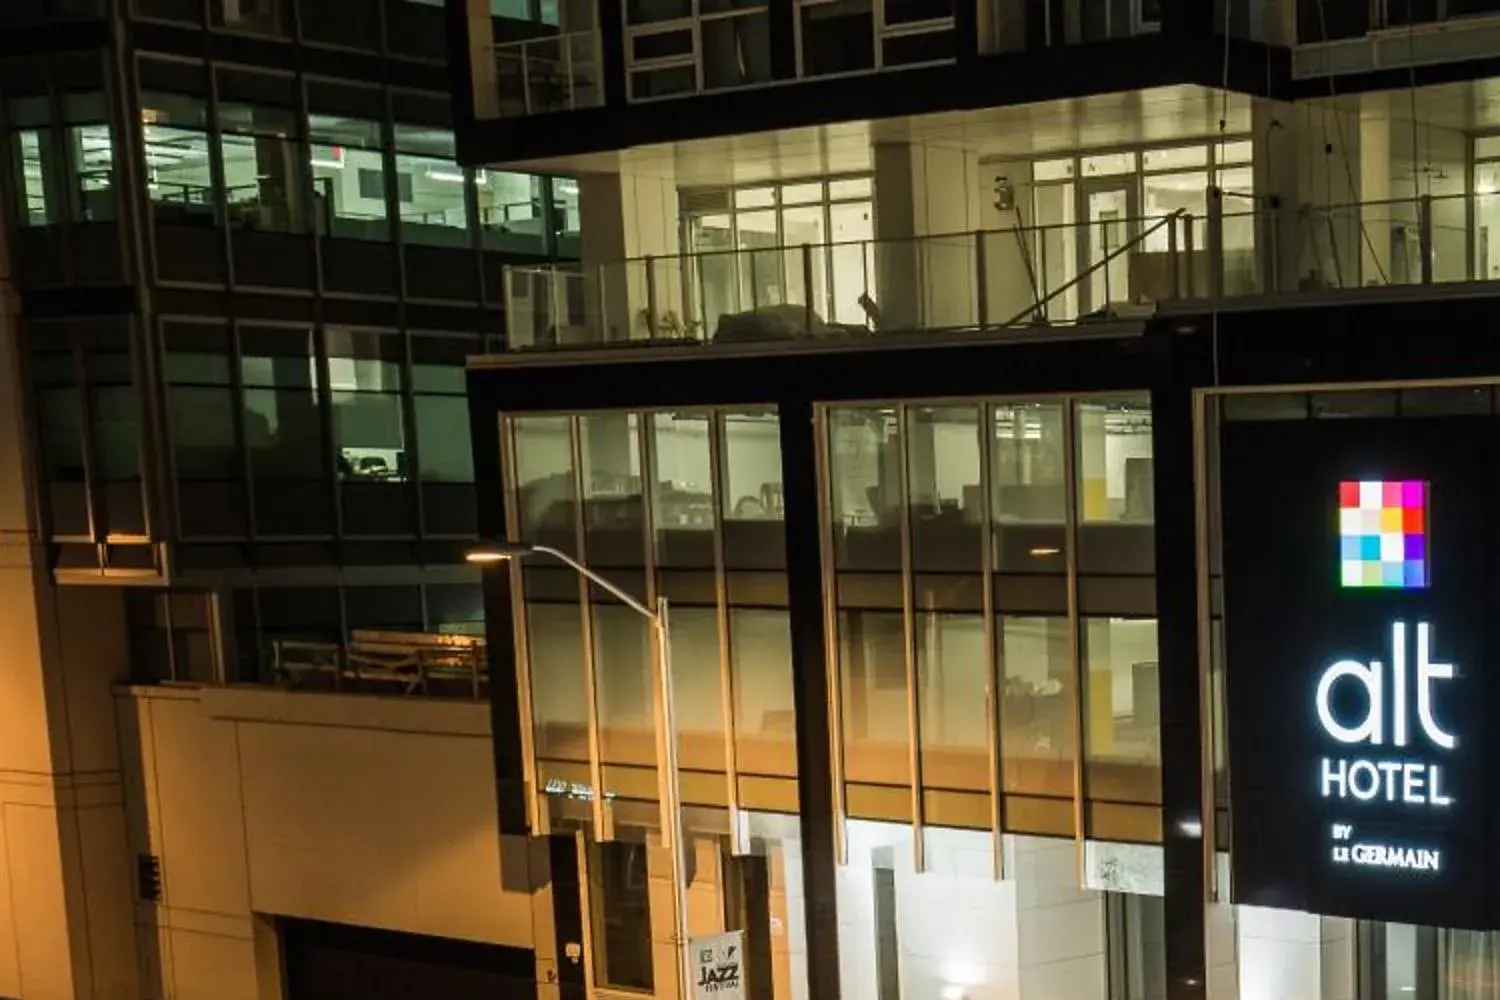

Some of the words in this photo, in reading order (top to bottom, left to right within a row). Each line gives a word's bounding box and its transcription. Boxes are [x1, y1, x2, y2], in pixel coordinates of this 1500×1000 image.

[1315, 621, 1457, 750] alt
[1321, 757, 1453, 806] HOTEL
[1332, 823, 1352, 840] BY
[1351, 843, 1440, 871] GERMAIN
[698, 964, 739, 986] JAZZ
